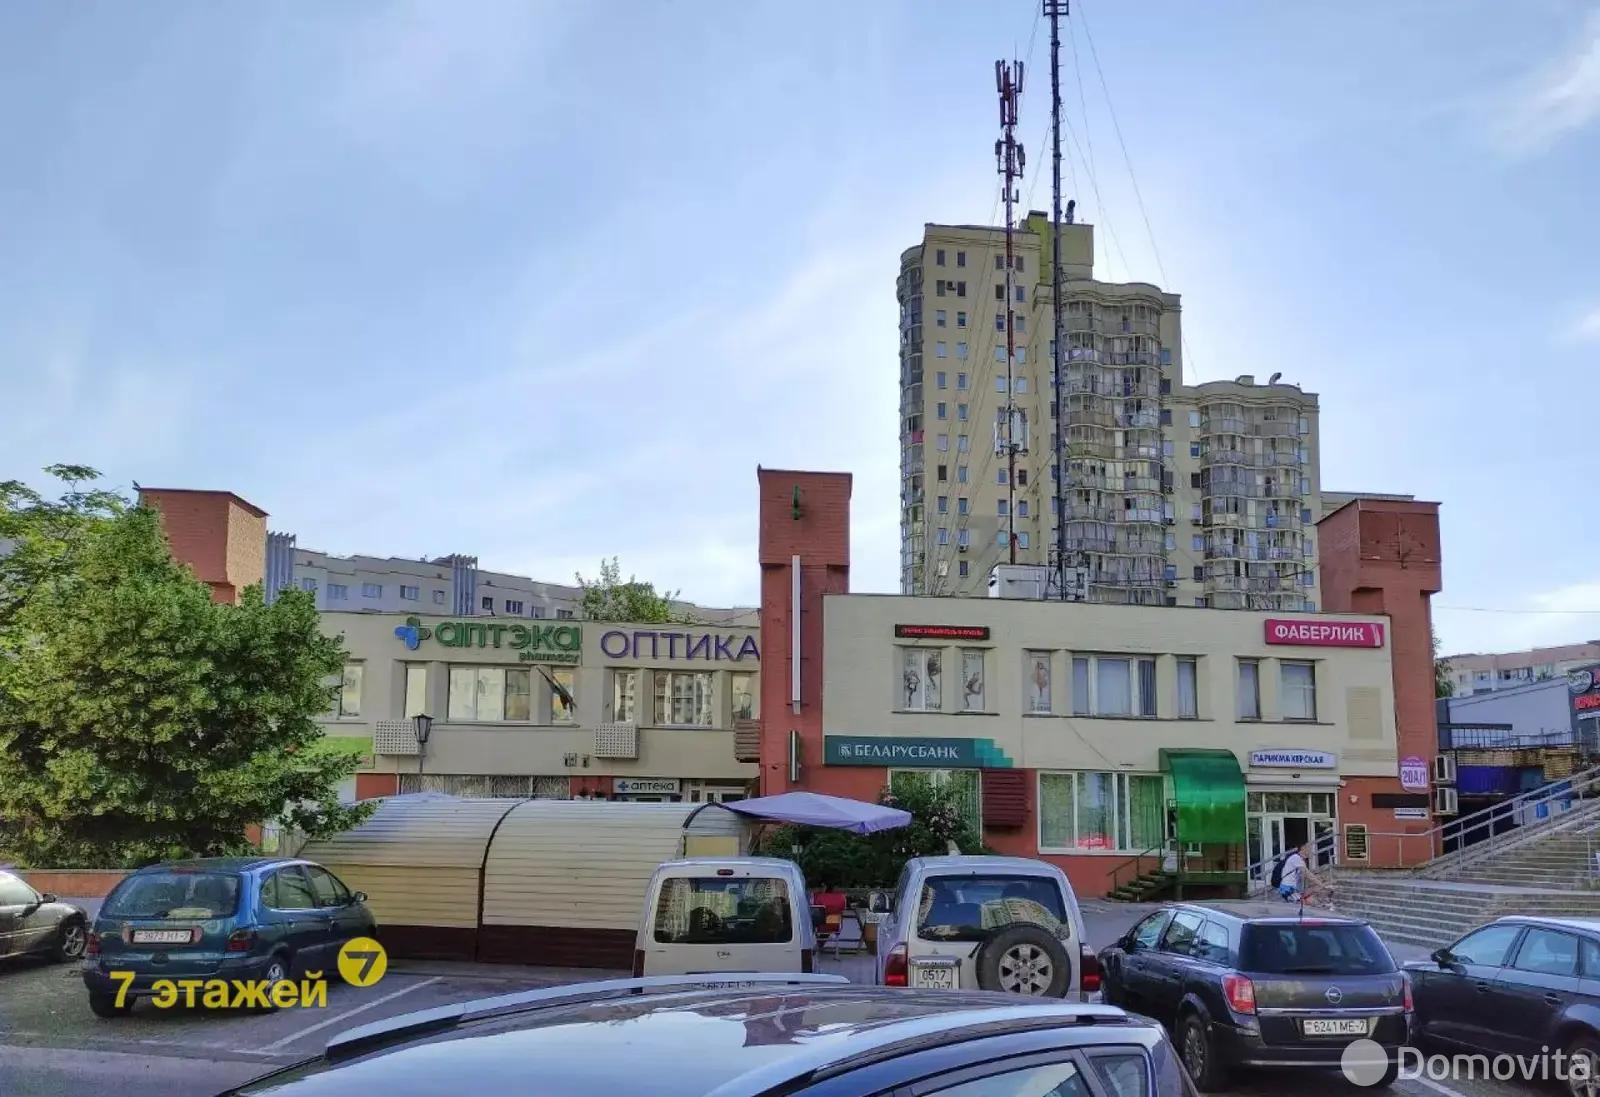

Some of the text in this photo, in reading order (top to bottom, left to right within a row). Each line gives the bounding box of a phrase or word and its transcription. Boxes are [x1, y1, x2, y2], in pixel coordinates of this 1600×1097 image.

[434, 621, 581, 651] аптэка
[1274, 624, 1365, 641] ФАБЕРЛИК
[600, 630, 760, 662] ОПТИКА
[854, 744, 959, 759] БЕЛАРУСБАНК
[1253, 753, 1325, 764] ПАРИКМАХЕРСКАЯ
[630, 782, 675, 791] аптека
[922, 970, 946, 981] 0517
[1314, 1021, 1337, 1033] 6241
